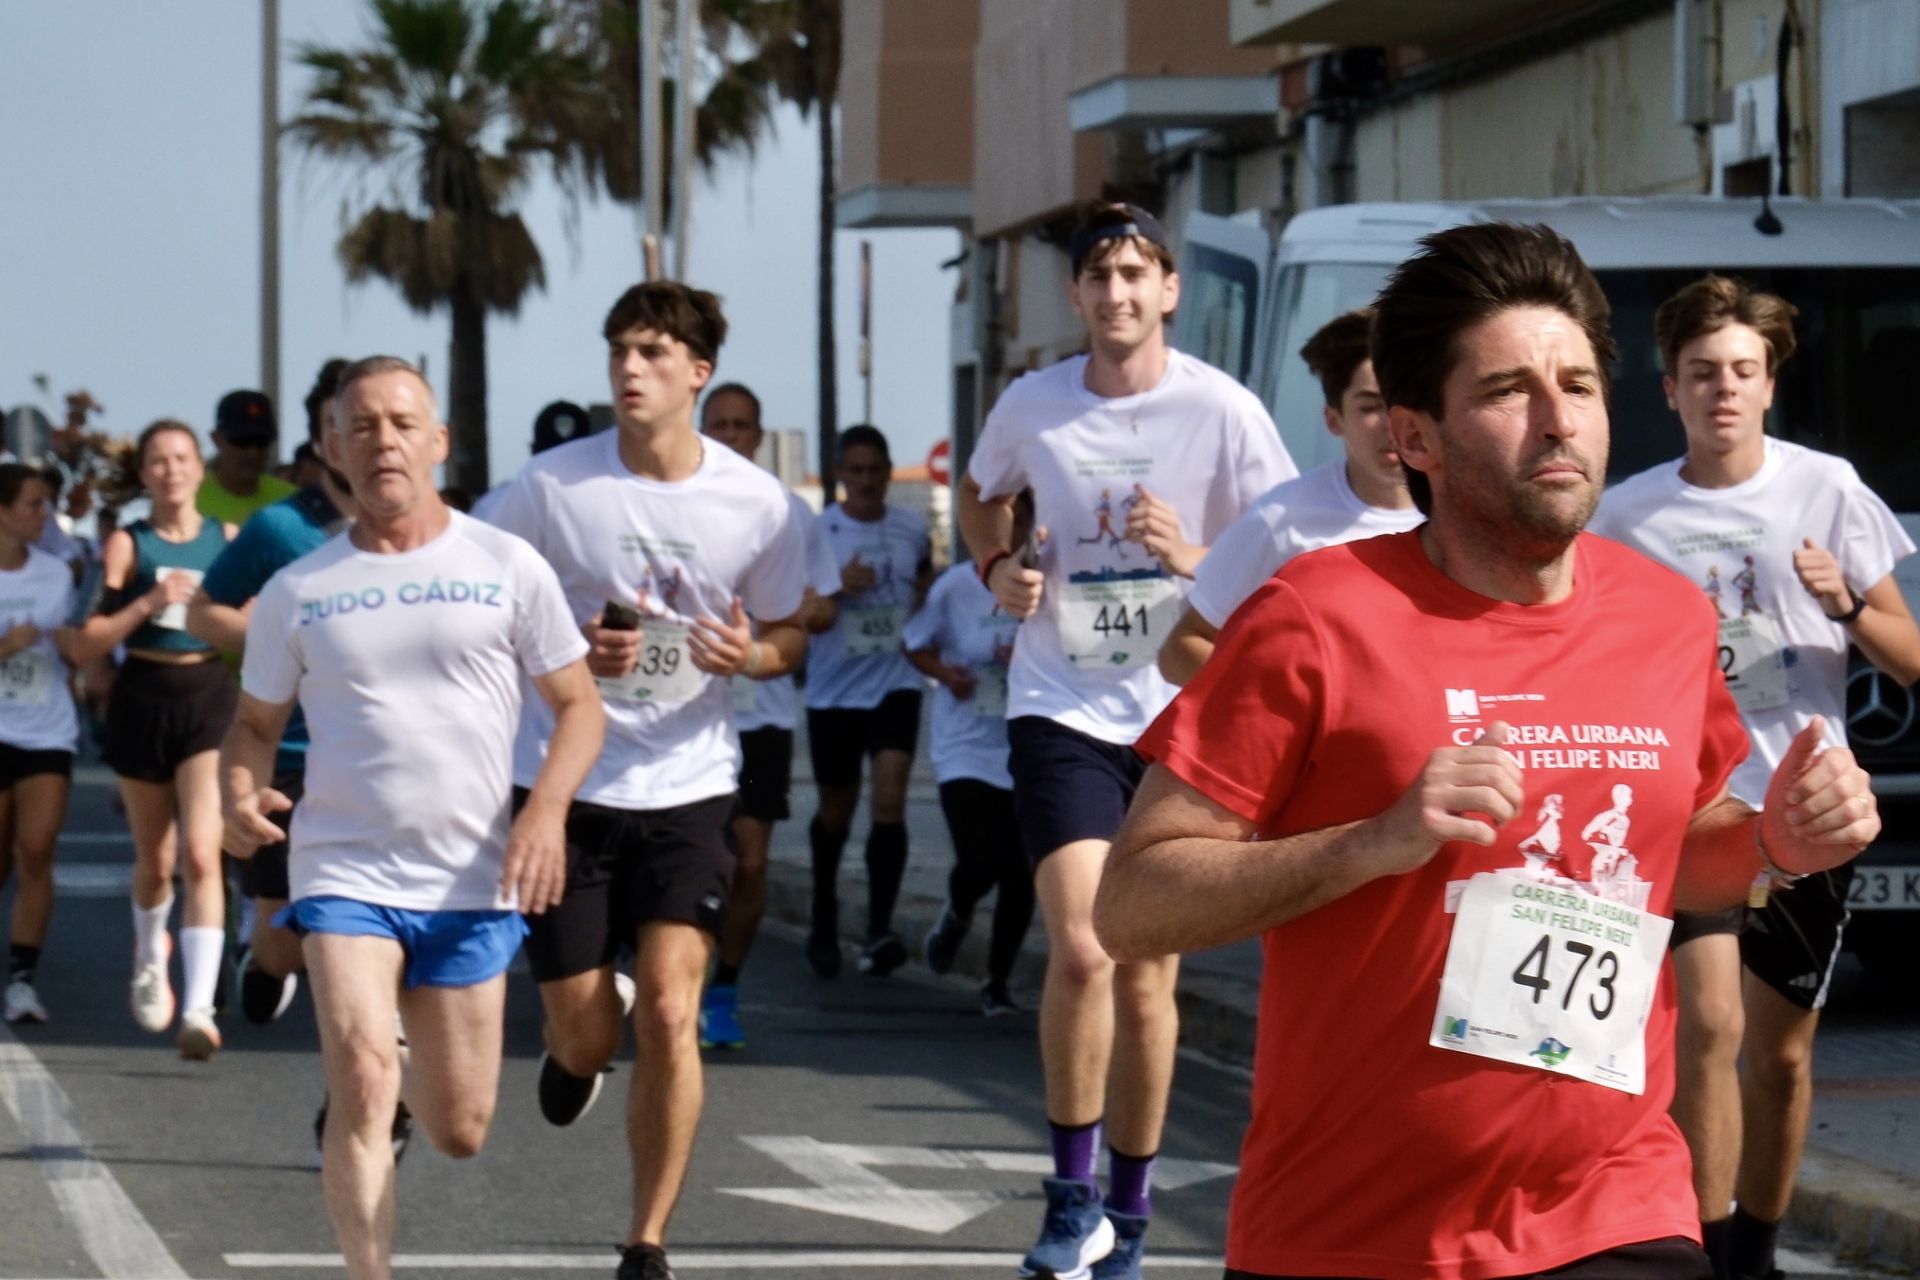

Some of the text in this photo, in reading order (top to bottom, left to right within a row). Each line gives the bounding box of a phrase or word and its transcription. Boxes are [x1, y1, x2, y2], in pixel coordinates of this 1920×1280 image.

[301, 576, 502, 626] JUDO CÁDIZ
[1093, 604, 1148, 638] 441
[633, 645, 680, 676] 39
[1572, 725, 1671, 747] URBANA
[1531, 750, 1601, 770] FELIPE
[1607, 750, 1660, 770] NERI
[1511, 904, 1547, 926] SAN
[1549, 912, 1603, 938] FELIPE
[1512, 884, 1641, 929] CARRERA URBANA
[1512, 933, 1619, 1021] 473
